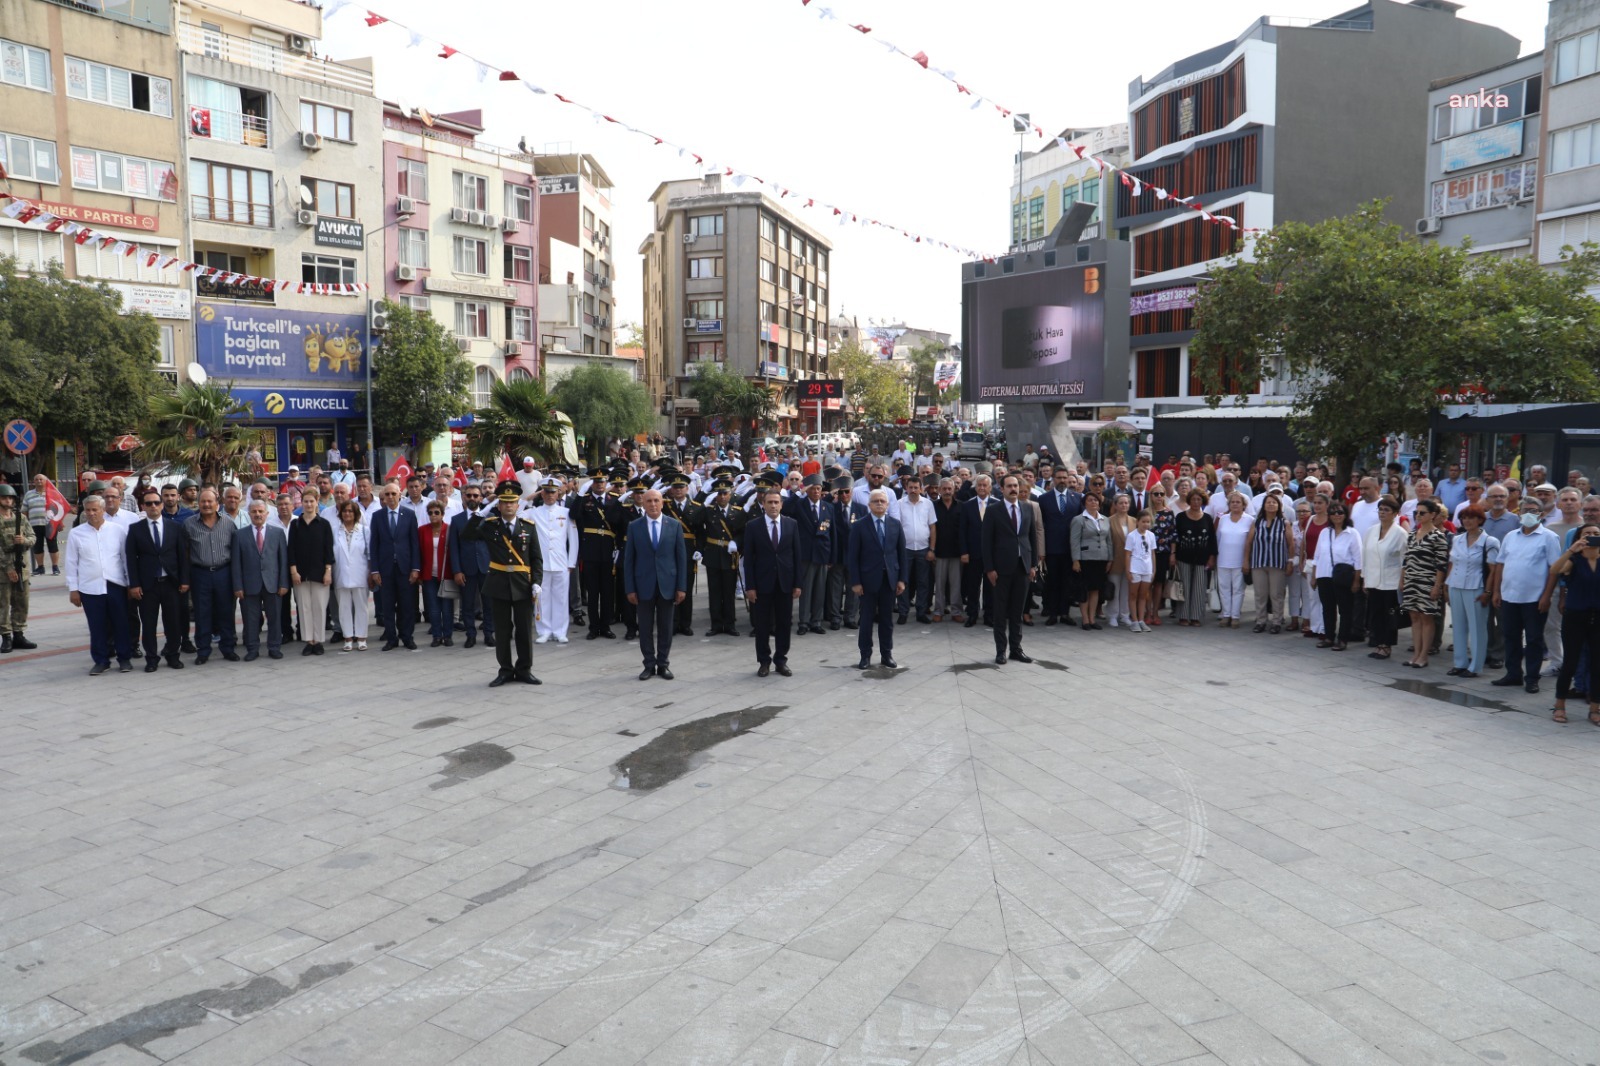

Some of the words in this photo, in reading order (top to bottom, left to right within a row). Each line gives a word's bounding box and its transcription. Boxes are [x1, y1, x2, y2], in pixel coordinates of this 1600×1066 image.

[538, 182, 576, 194] TEL
[38, 203, 78, 217] EMEK
[318, 220, 362, 237] AVUKAT
[1046, 327, 1064, 338] Hava
[224, 333, 280, 352] bağlan
[225, 350, 286, 368] hayata!
[1027, 346, 1058, 361] Deposu
[808, 383, 821, 395] 29
[980, 385, 1020, 399] JEOTERMAL
[1021, 384, 1058, 396] KURUTMA
[1059, 380, 1085, 395] TESİSİ
[289, 397, 349, 410] TURKCELL
